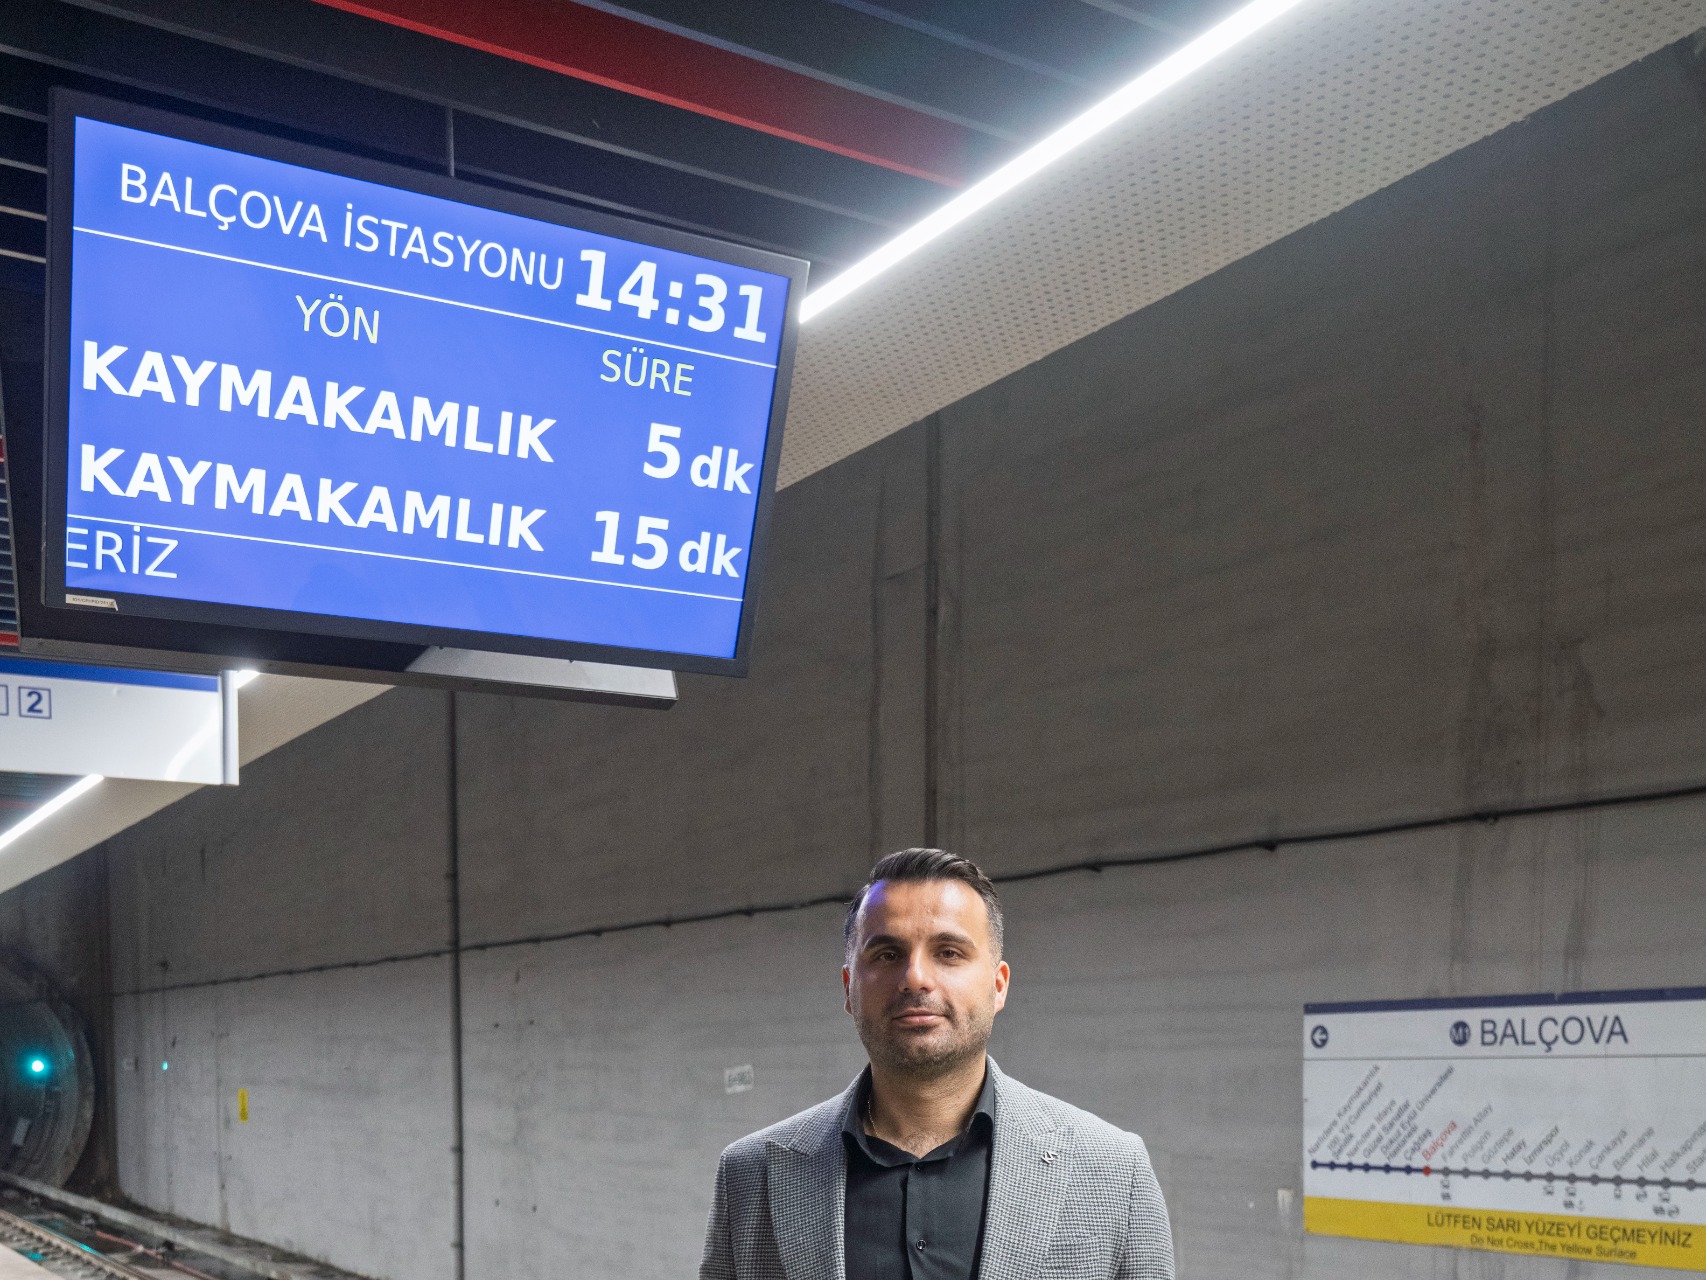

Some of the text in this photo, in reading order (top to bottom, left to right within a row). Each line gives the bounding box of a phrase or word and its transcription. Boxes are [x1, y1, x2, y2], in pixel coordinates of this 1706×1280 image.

[121, 163, 564, 291] BALÇOVA İSTASYONU
[575, 249, 767, 343] 14:31
[295, 295, 380, 344] YÖN
[600, 347, 695, 397] SÜRE
[82, 340, 754, 494] KAYMAKAMLIK 5 dk
[79, 443, 742, 578] KAYMAKAMLIK 15 dk
[66, 525, 179, 579] ERİZ
[26, 690, 44, 714] 2
[1480, 1015, 1629, 1052] BALÇOVA
[1422, 1120, 1457, 1161] Balçova
[1502, 1138, 1526, 1165] Hatay
[1567, 1139, 1595, 1168] Konak
[1613, 1126, 1655, 1171] Basmane
[1637, 1147, 1659, 1172] Hilal
[1426, 1211, 1693, 1248] LÜTFEN SARI YÜZEYİ GEÇMEYİNİZ
[1470, 1233, 1484, 1245] Do
[1487, 1235, 1504, 1247] Not
[1538, 1239, 1557, 1252] The
[1560, 1241, 1593, 1255] Yellow
[1595, 1244, 1637, 1259] Surface
